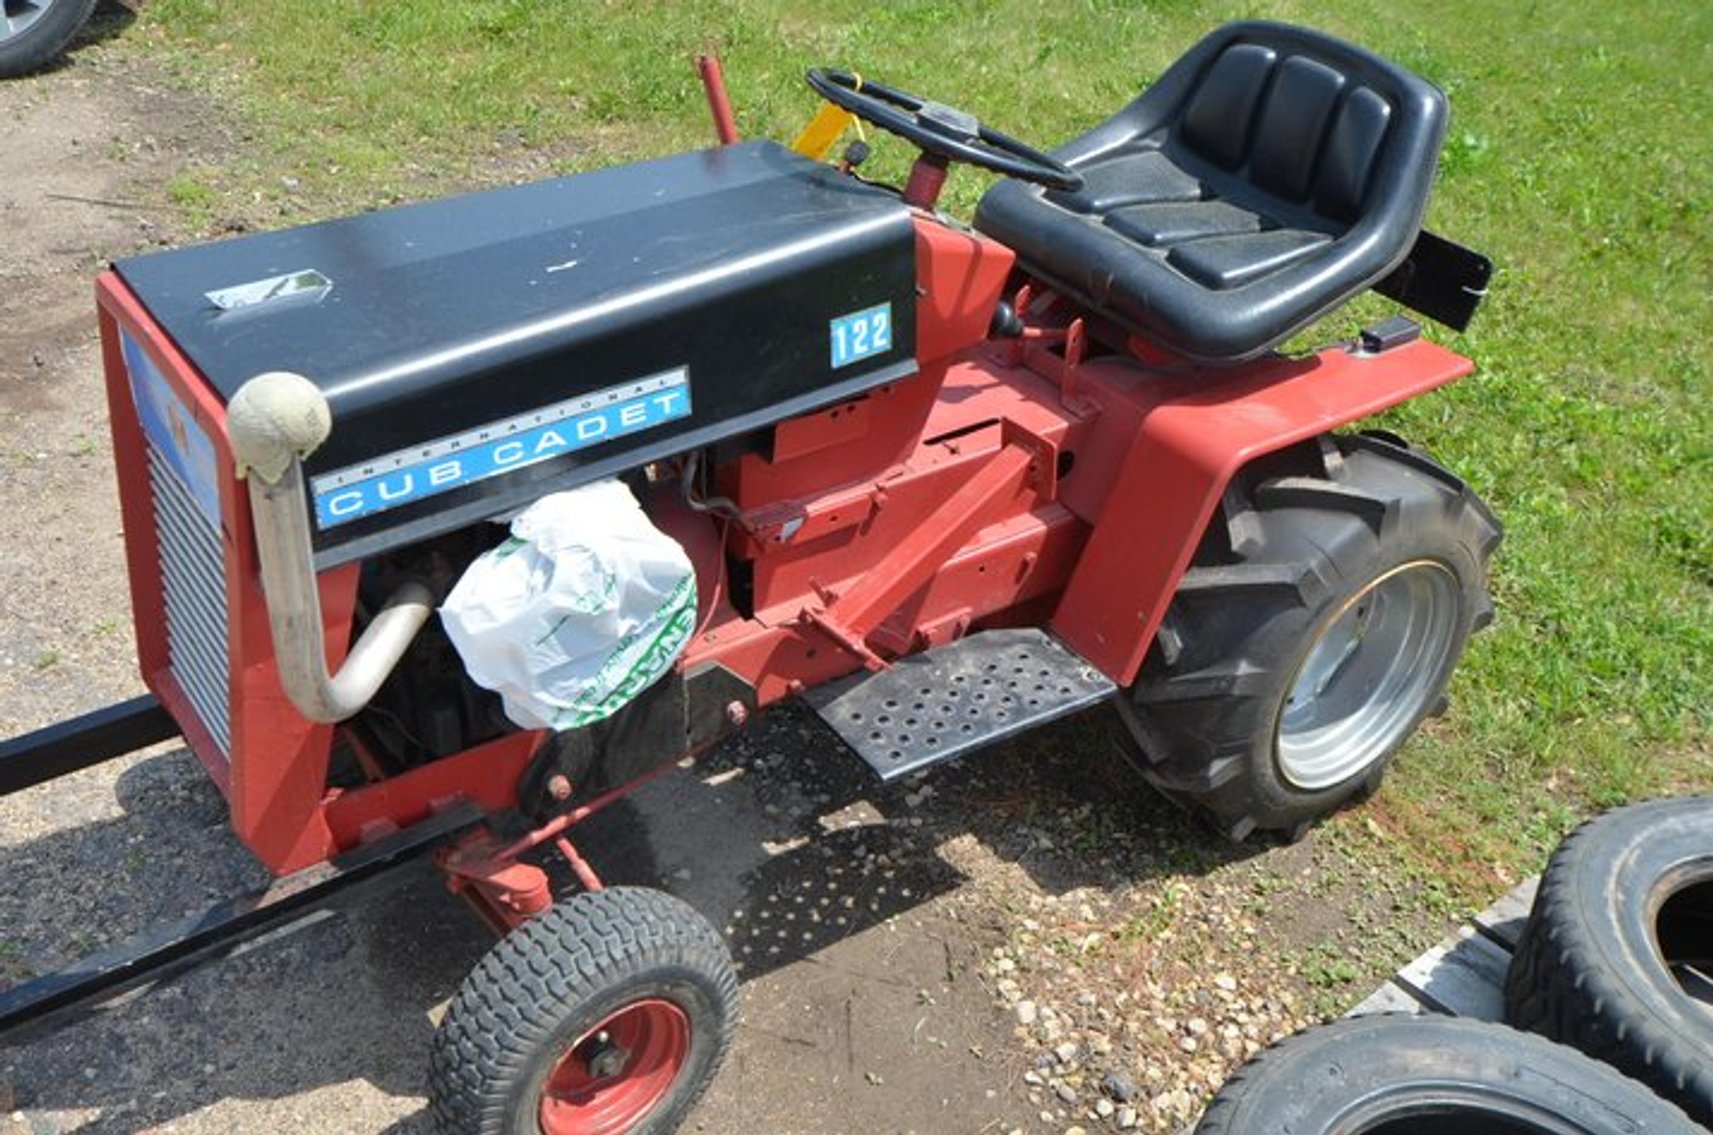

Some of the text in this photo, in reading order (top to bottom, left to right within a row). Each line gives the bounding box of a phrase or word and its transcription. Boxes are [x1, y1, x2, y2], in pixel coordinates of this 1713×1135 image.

[837, 312, 887, 361] 122
[328, 393, 681, 516] CUB CADET
[337, 379, 669, 485] INTERNATIONAL
